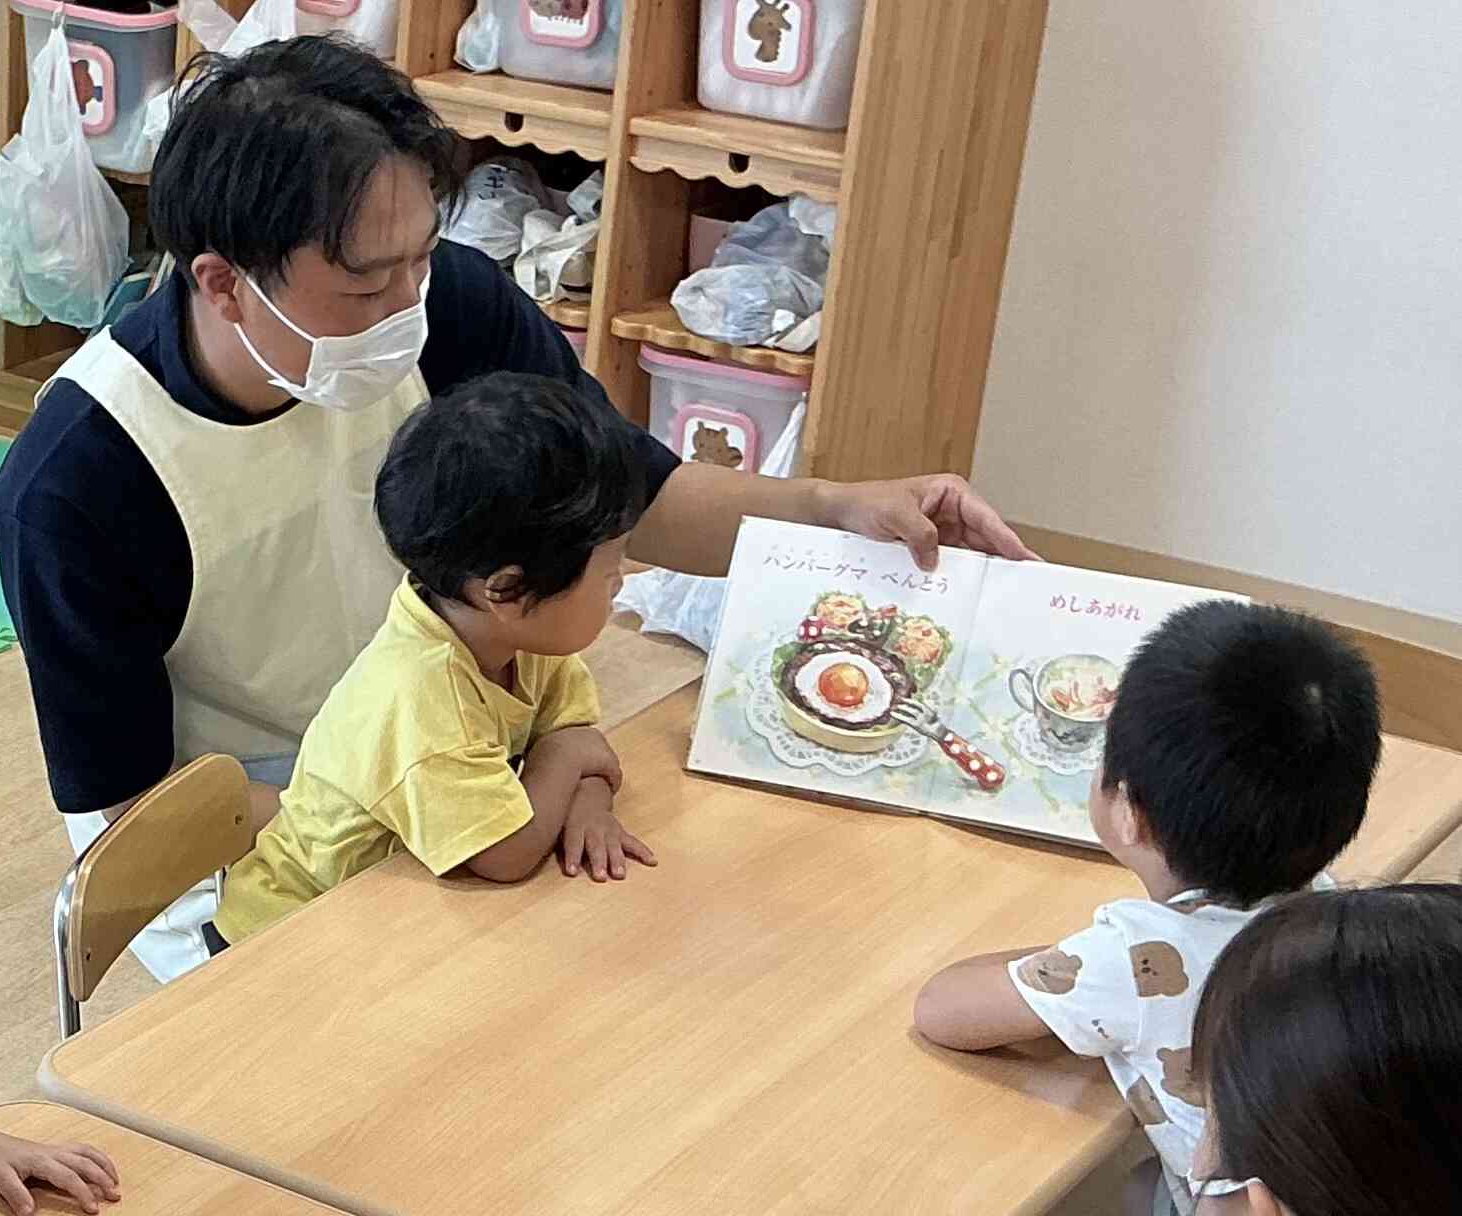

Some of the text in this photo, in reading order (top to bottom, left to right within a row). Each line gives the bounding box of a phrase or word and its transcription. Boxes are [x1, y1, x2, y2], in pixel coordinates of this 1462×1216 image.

[1049, 594, 1141, 621] めしあがれ
